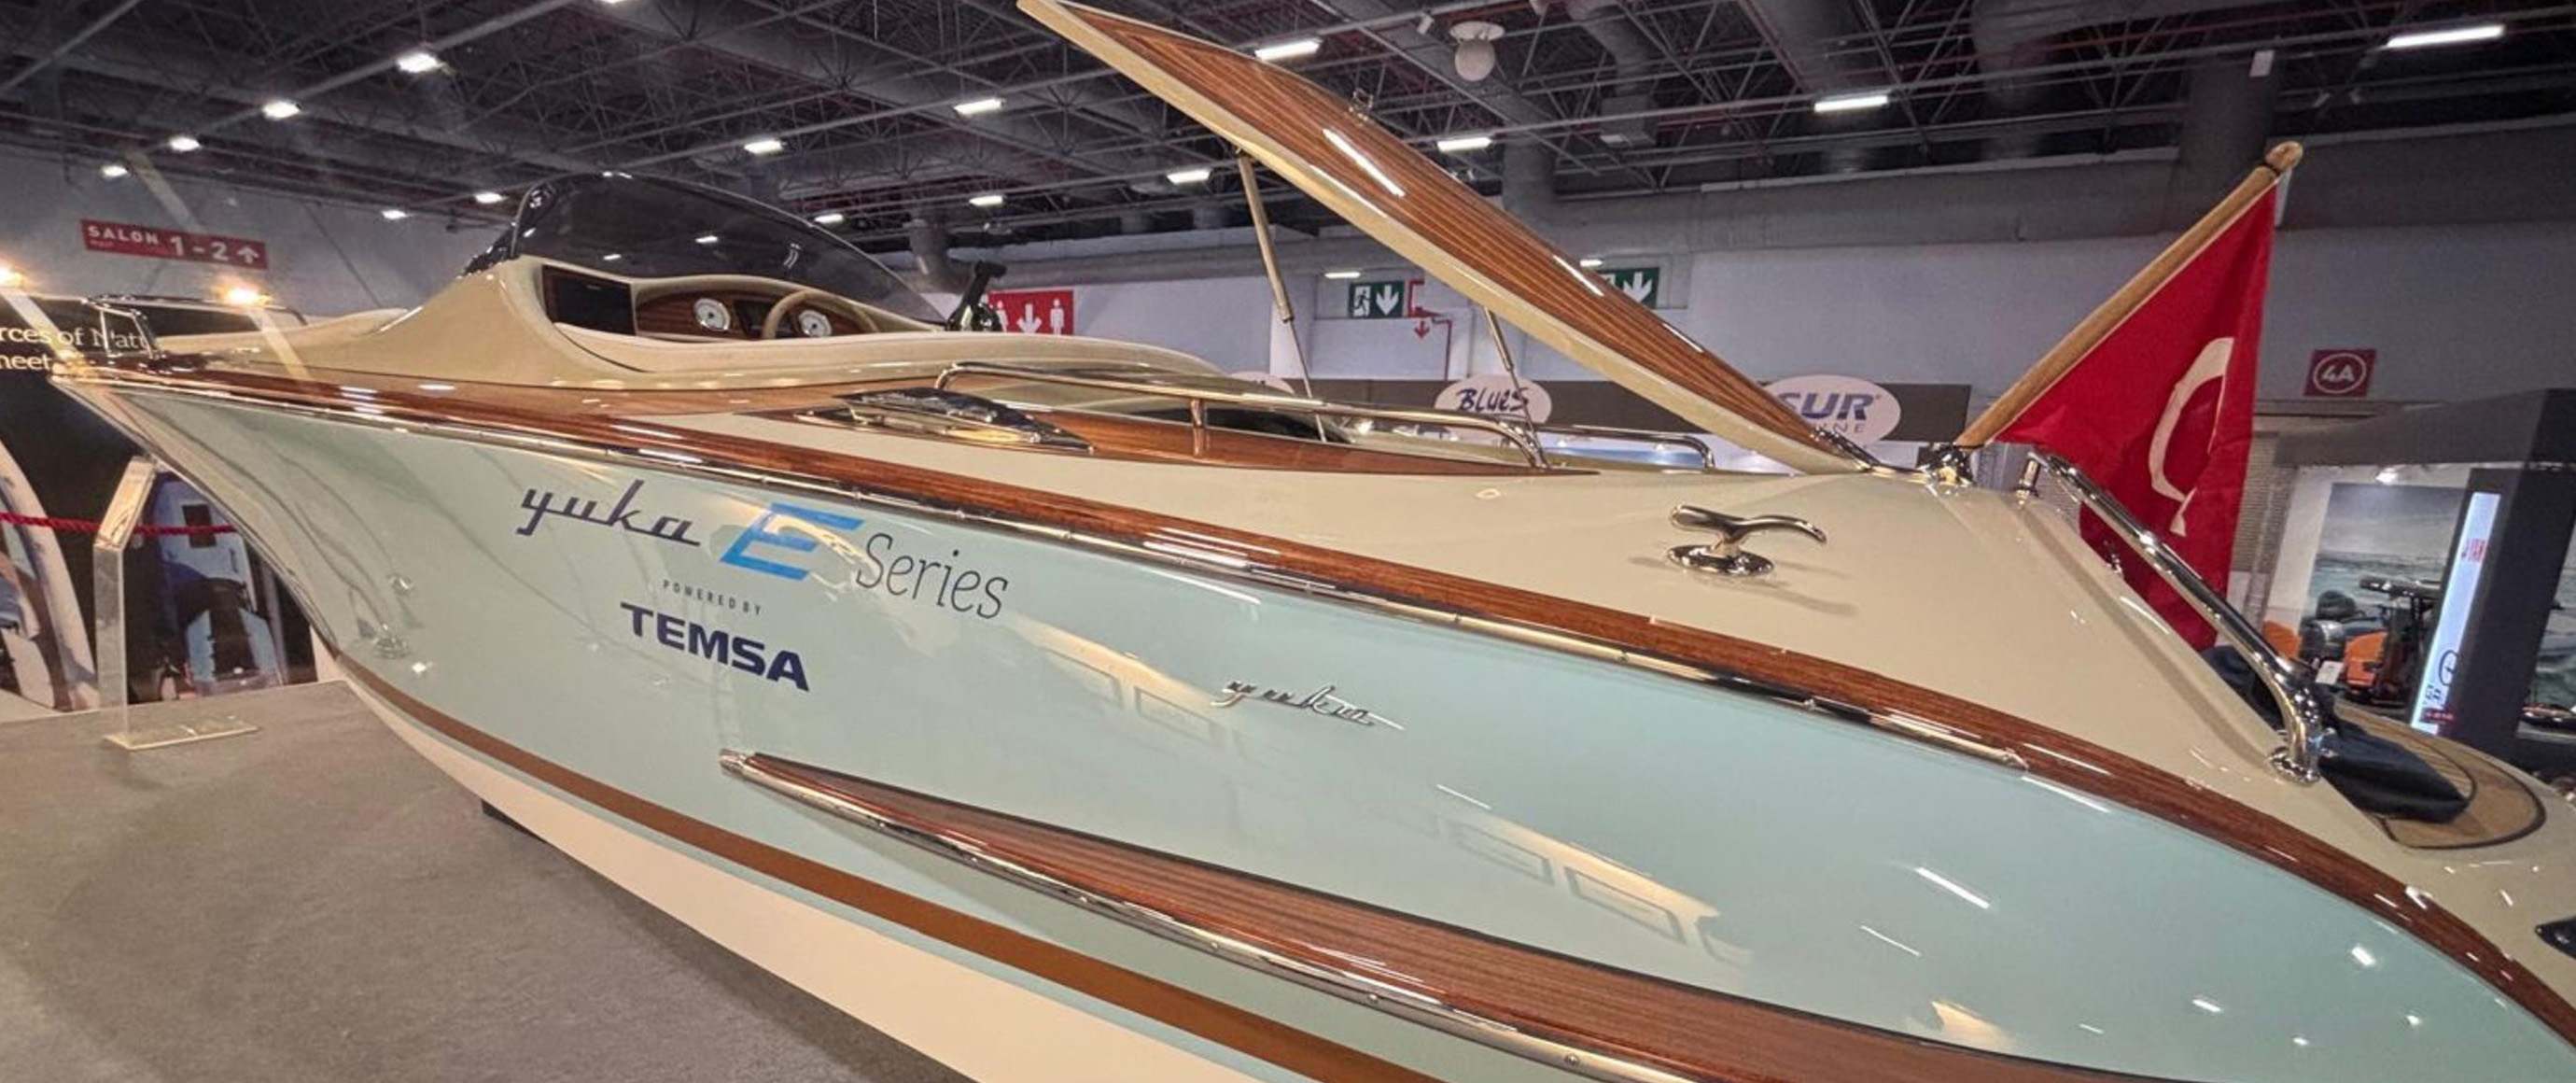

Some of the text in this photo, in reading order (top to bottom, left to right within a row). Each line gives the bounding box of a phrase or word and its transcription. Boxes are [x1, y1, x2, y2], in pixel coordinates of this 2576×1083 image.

[89, 225, 159, 245] SALON
[56, 328, 84, 345] of
[2321, 363, 2356, 383] 4A
[516, 478, 1009, 619] yuka E Series
[663, 579, 762, 615] POWERED BY
[620, 601, 810, 692] TEMSA
